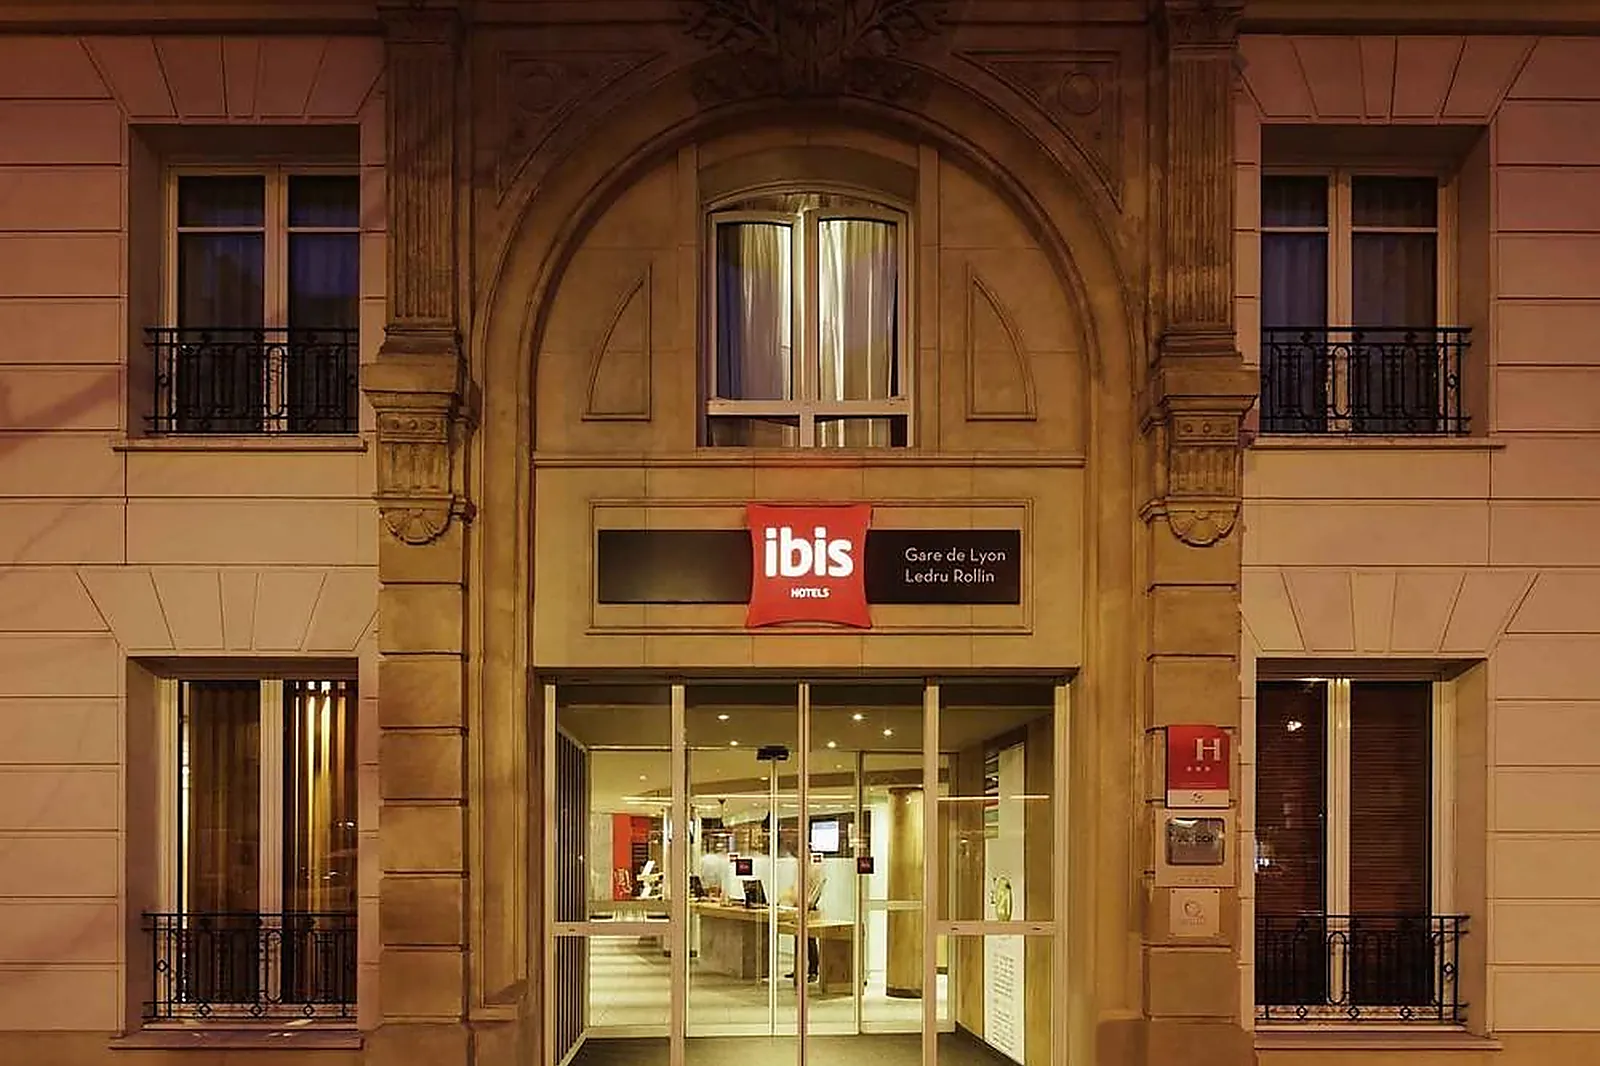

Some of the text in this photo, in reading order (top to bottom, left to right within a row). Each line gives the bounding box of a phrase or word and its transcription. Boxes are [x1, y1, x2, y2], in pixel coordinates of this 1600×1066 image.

[765, 527, 853, 577] ibis
[905, 547, 1006, 565] Gare de Lyon
[905, 568, 995, 582] Ledru Rollin
[791, 588, 830, 598] HOTELS
[1196, 738, 1220, 761] H
